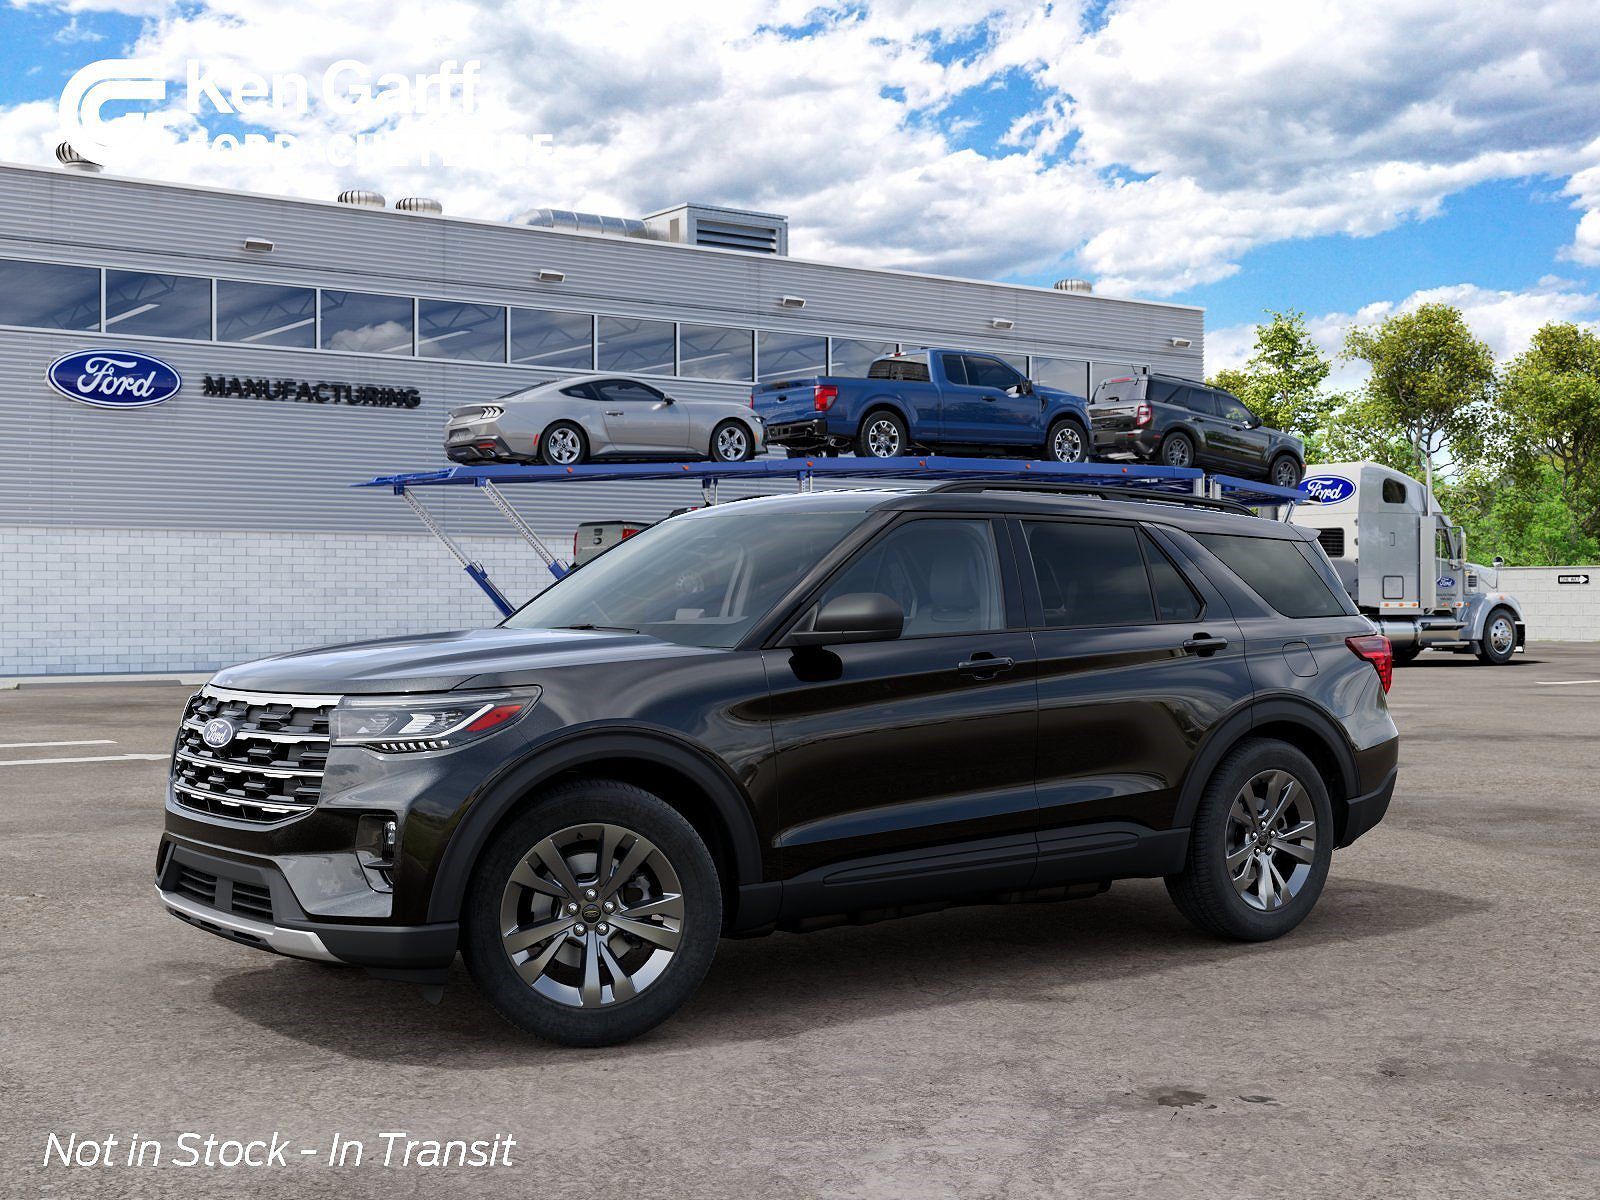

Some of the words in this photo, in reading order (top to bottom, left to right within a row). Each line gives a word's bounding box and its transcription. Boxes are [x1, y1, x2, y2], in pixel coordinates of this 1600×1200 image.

[76, 356, 157, 398] Ford
[202, 374, 421, 409] MANUFACTURING
[206, 722, 228, 744] Ford
